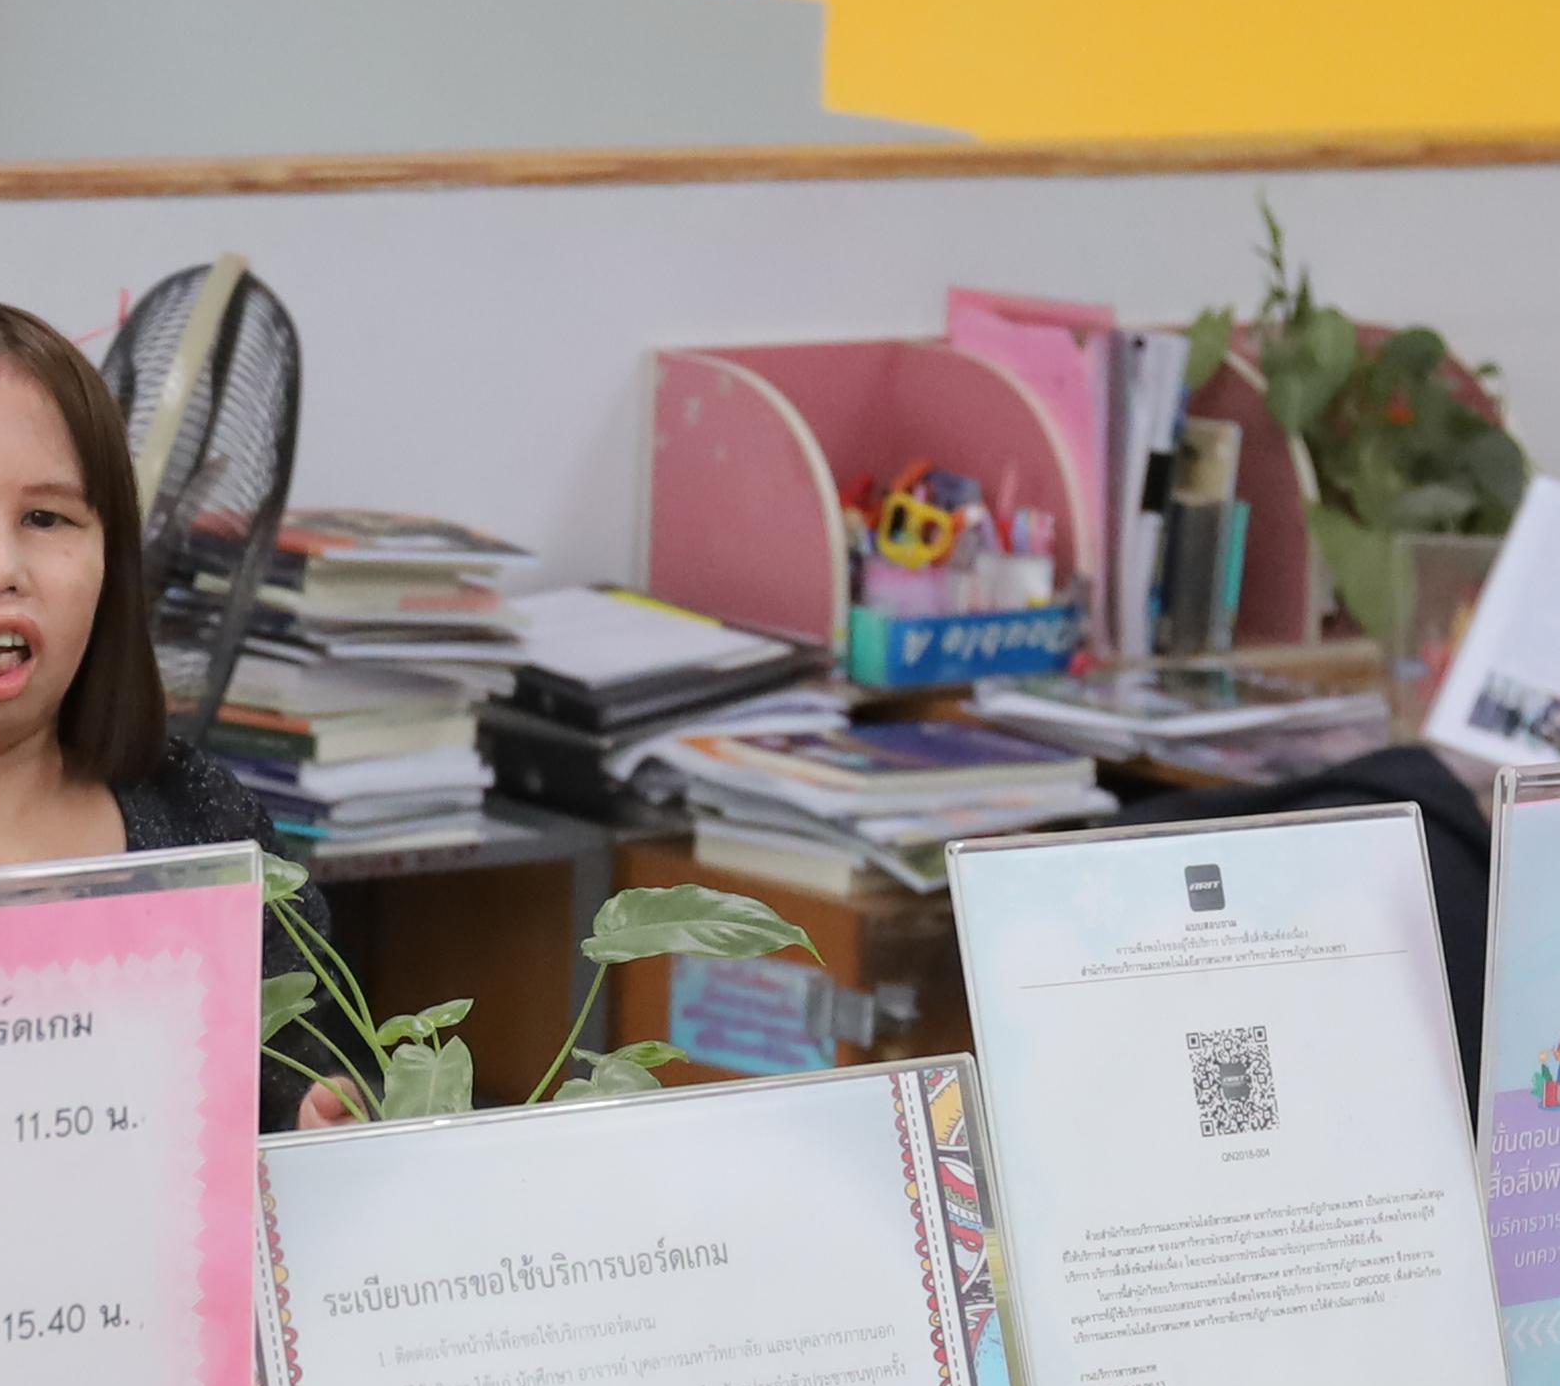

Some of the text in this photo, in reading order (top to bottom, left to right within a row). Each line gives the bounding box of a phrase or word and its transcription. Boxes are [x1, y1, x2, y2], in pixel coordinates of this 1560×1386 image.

[14, 1105, 93, 1143] 11.50
[107, 1104, 138, 1130] น.
[324, 1237, 728, 1317] ระเบียบการขอใช้บริการบอร์ดเกม
[1353, 1273, 1391, 1288] QRCODE
[2, 1303, 86, 1344] 15.40
[99, 1301, 131, 1329] น.
[377, 1351, 385, 1368] 1.
[579, 1356, 628, 1381] อาจารย์
[634, 1337, 761, 1381] บุคลากรมหาวิทยาลัย
[766, 1321, 895, 1356] และบุคลากรภายนอก
